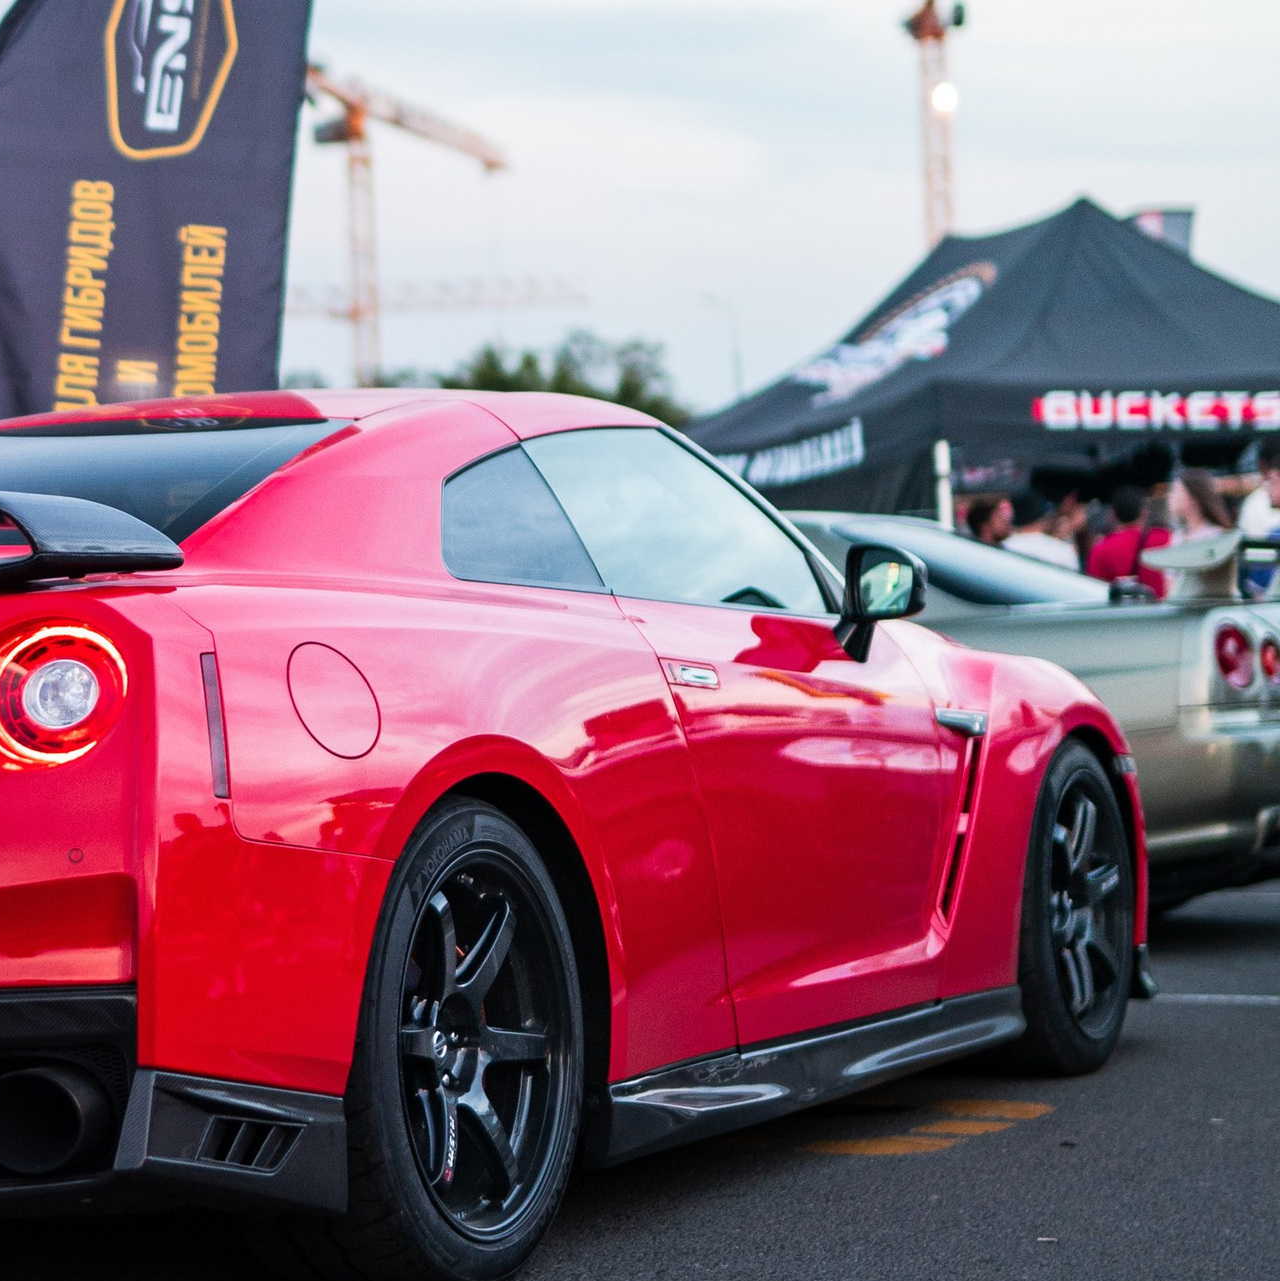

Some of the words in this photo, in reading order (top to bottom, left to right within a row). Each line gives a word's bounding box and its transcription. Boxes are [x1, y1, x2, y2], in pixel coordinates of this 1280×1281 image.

[58, 180, 116, 349] ГИБРИДОВ
[116, 359, 158, 385] И
[420, 826, 471, 880] YOKOHAMA
